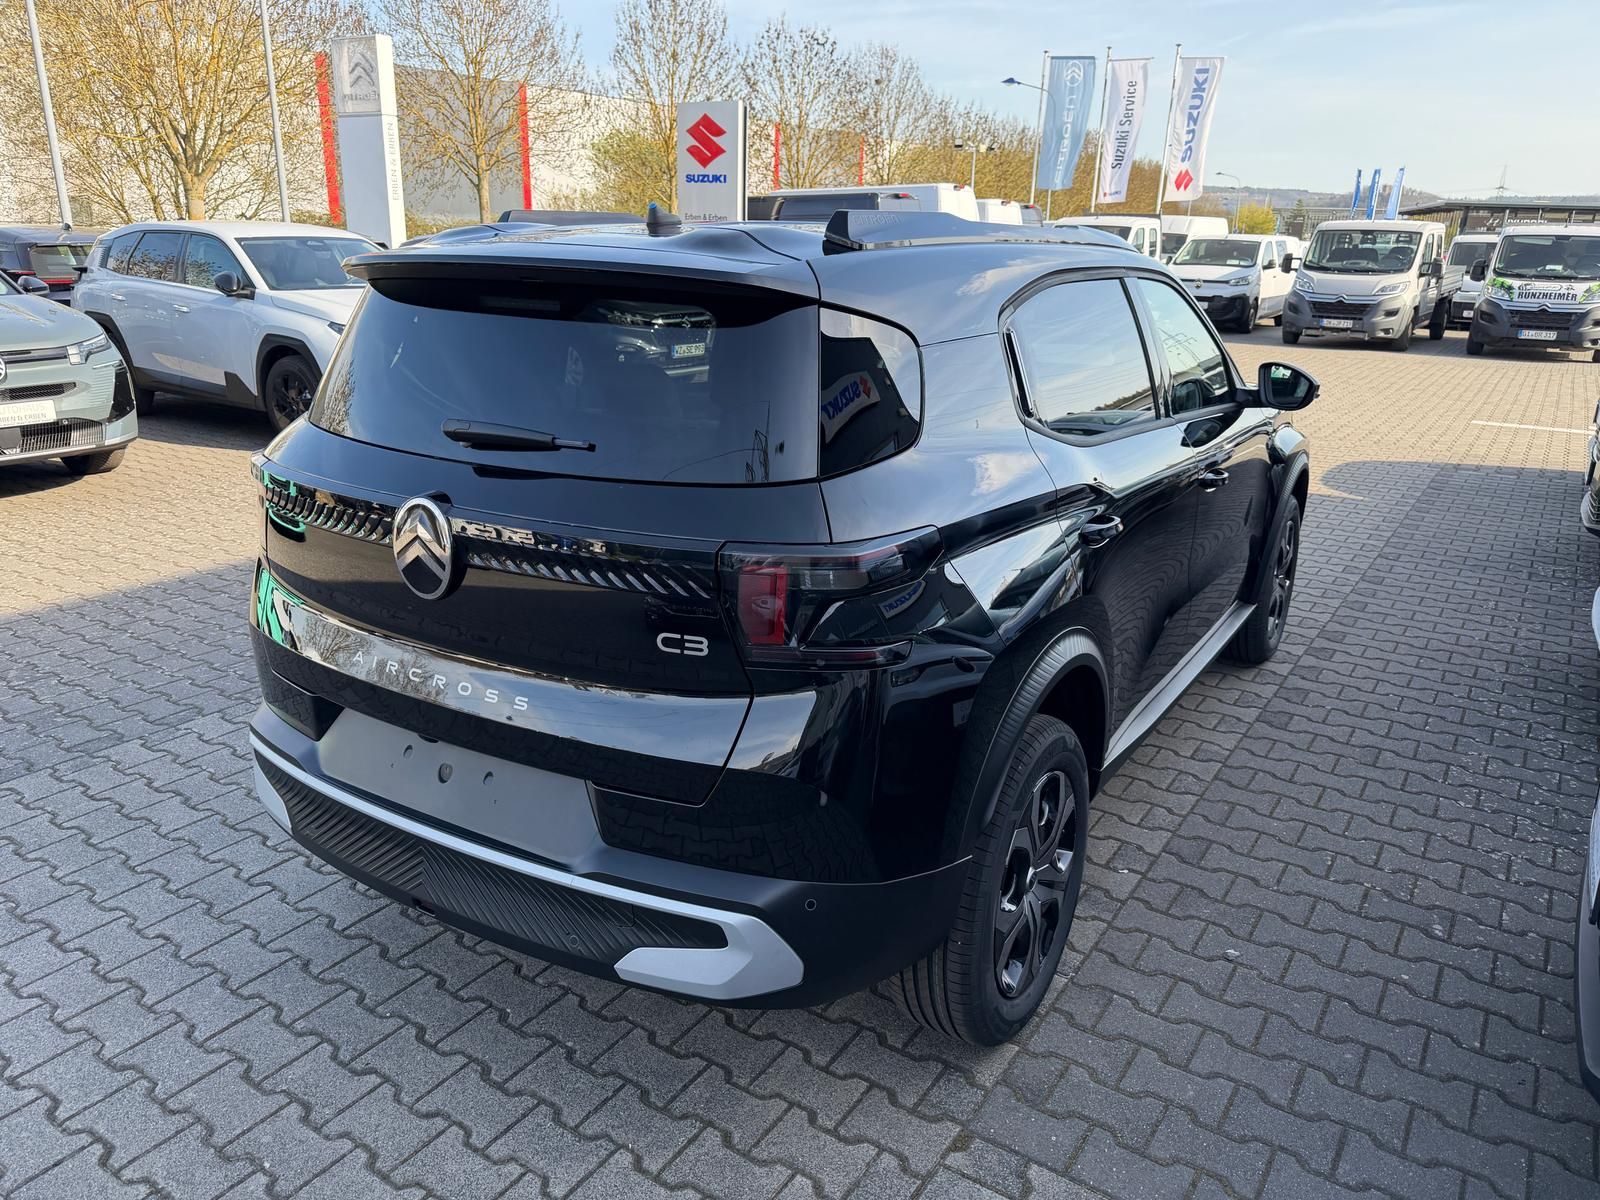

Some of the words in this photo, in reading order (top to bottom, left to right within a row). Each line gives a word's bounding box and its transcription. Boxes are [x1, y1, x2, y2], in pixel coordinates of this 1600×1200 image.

[1119, 80, 1137, 127] Service
[1181, 68, 1210, 163] SUZUKI
[1111, 131, 1130, 169] Suzuki
[685, 174, 727, 184] SUZUKI
[656, 632, 709, 656] C3
[352, 651, 529, 711] AIRCROSS
